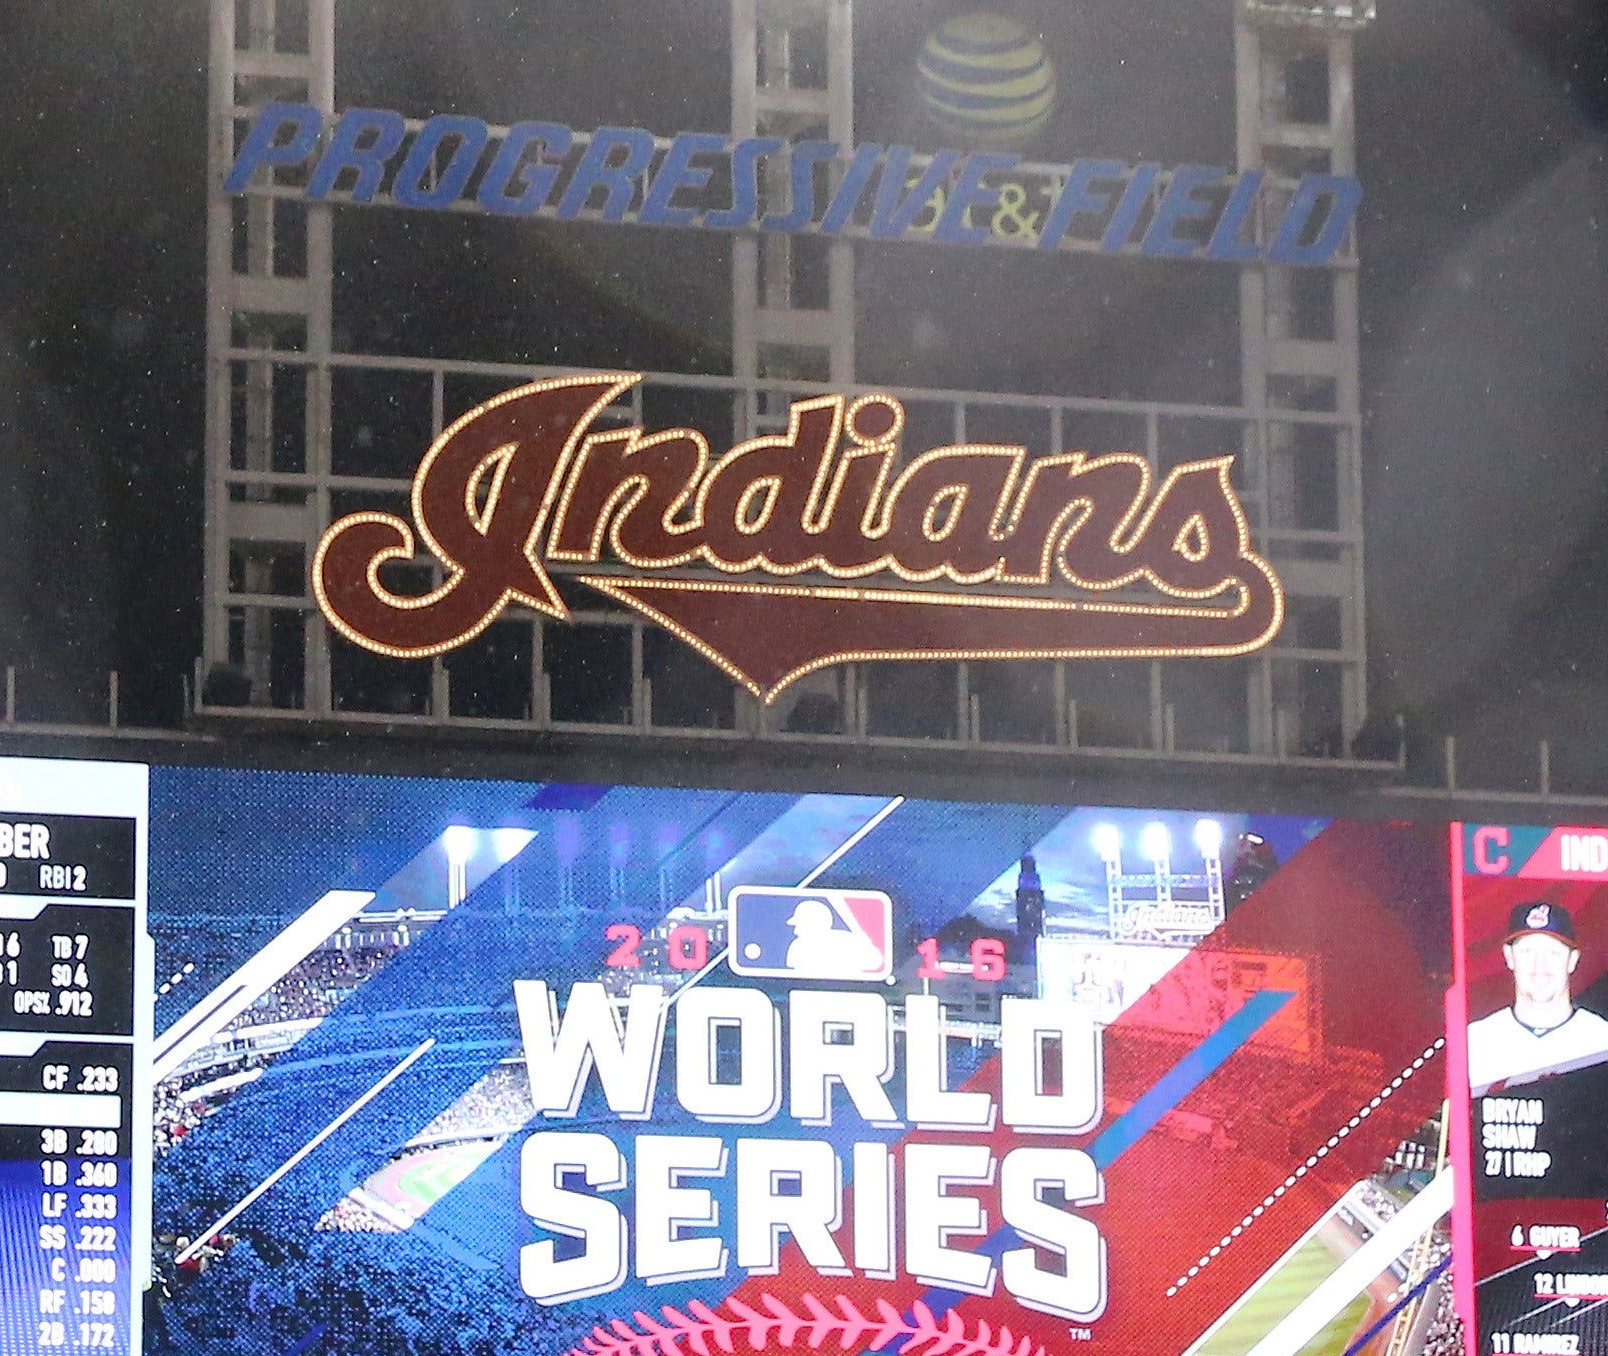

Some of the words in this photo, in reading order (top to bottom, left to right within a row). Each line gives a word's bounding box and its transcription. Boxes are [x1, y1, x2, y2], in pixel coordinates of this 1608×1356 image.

[224, 101, 1024, 247] PROGRESSIVE
[1036, 159, 1363, 268] FIELD
[311, 371, 1285, 703] Indians
[513, 978, 1104, 1132] WORLD
[44, 1065, 68, 1089] CF
[78, 1067, 117, 1091] .233
[1483, 1098, 1542, 1124] BRYAN
[42, 1129, 67, 1153] 3B
[1482, 1124, 1536, 1149] SHAW
[42, 1161, 66, 1185] 1B
[77, 1162, 116, 1186] .360
[43, 1193, 66, 1217] LF
[76, 1194, 116, 1218] .333
[40, 1225, 65, 1249] SS
[75, 1226, 115, 1250] .222
[519, 1131, 1109, 1324] SERIES
[52, 1257, 65, 1281] C
[75, 1258, 115, 1283] .000
[40, 1289, 65, 1313] RF
[38, 1322, 64, 1345] 2B
[73, 1323, 114, 1347] .172
